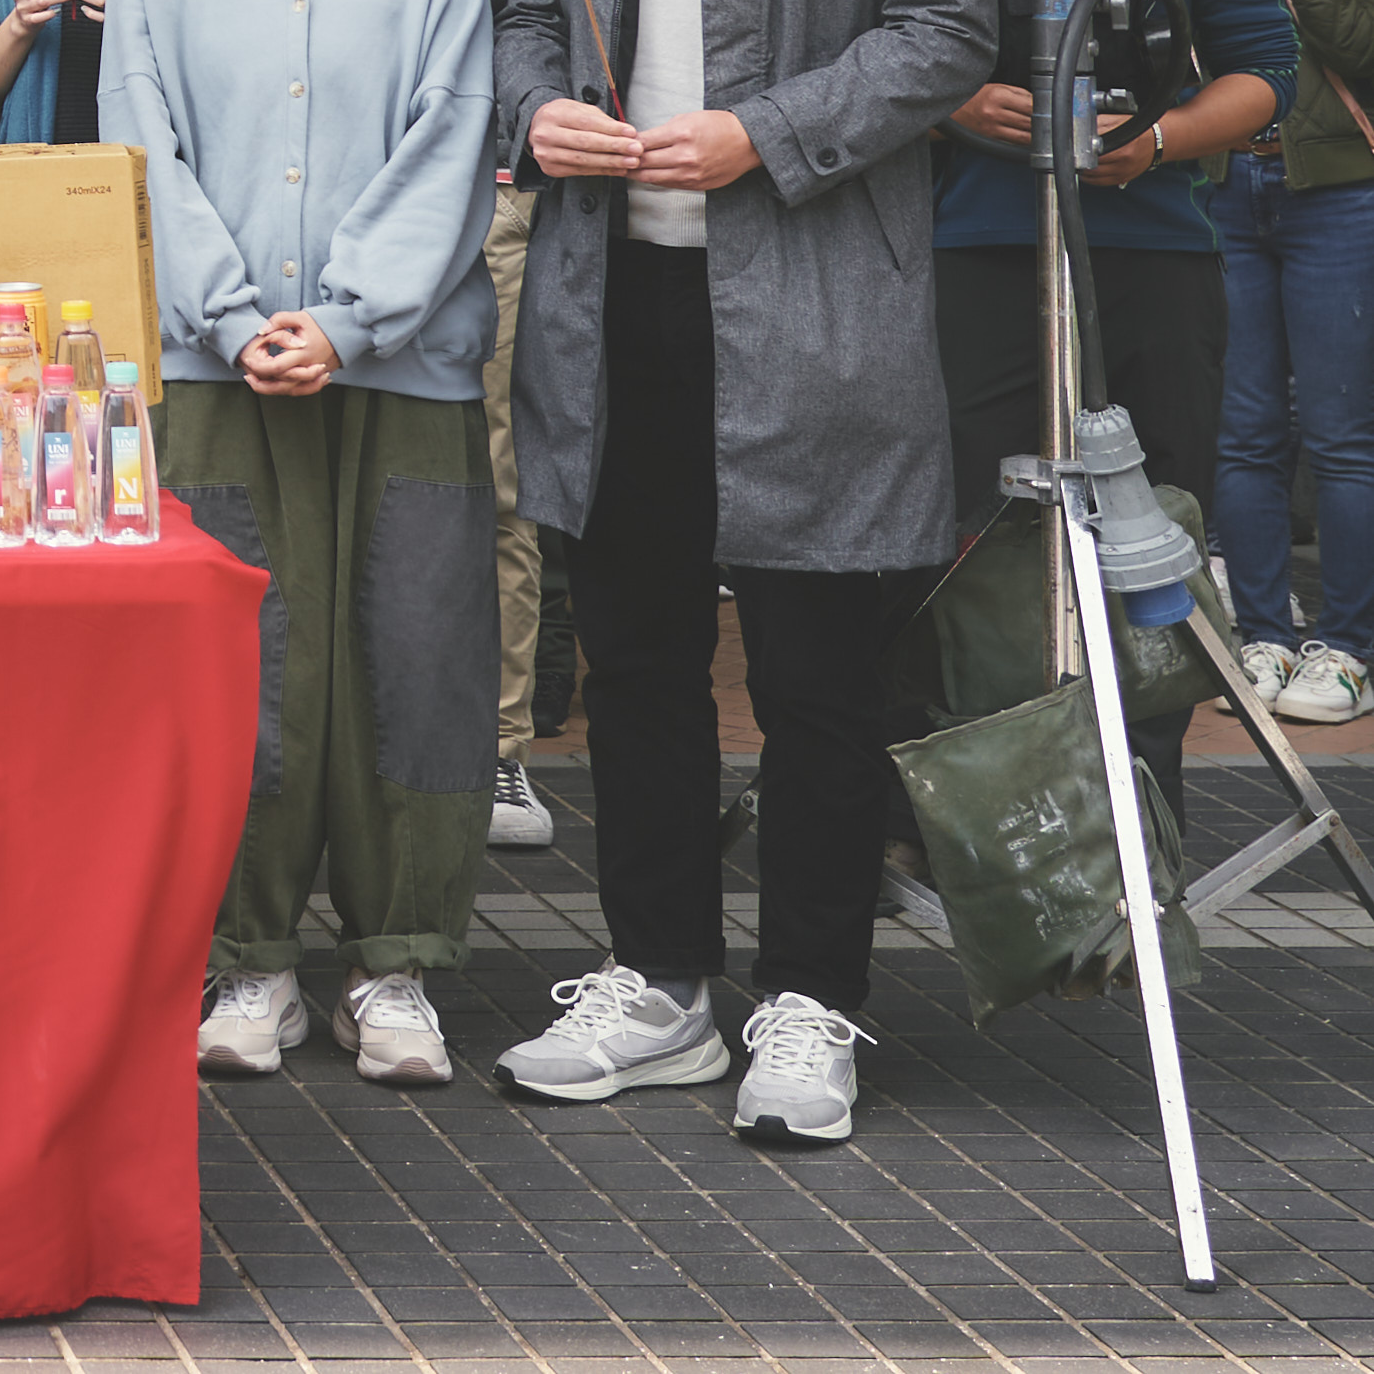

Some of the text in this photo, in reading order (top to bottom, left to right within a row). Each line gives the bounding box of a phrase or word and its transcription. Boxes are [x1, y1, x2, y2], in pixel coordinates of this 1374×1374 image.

[80, 403, 97, 413] NI
[48, 443, 69, 454] UNI
[116, 438, 137, 448] UNI
[117, 477, 138, 499] N
[54, 488, 67, 505] r
